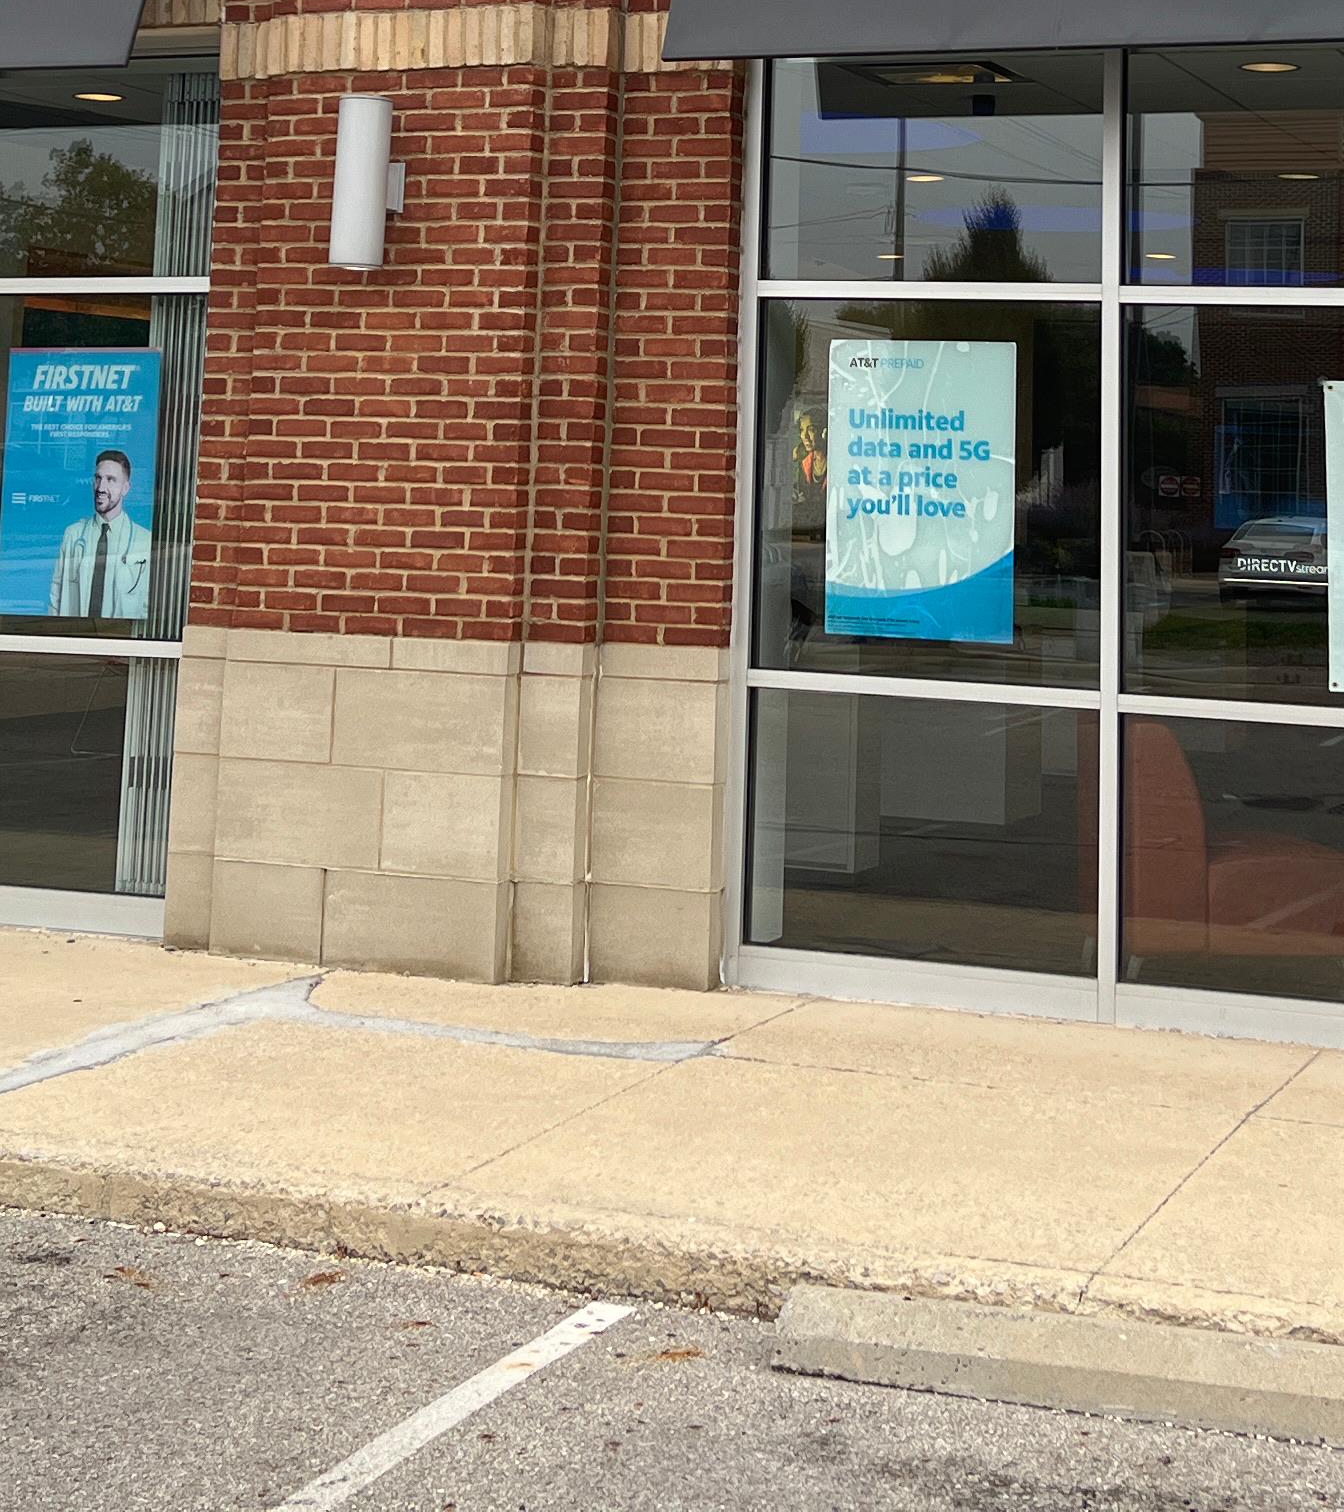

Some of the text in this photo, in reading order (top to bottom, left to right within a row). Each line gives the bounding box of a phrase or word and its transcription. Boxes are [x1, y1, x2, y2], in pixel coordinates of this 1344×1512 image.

[849, 357, 925, 369] AT&T PREPAID
[32, 364, 137, 390] FIRSTNET
[23, 394, 144, 413] BUILT WITH AT&T
[849, 408, 966, 432] Unlimited
[848, 436, 991, 461] data and 5G
[847, 466, 958, 493] at a price
[846, 494, 966, 520] you'll love
[1237, 557, 1297, 573] DIRECTV
